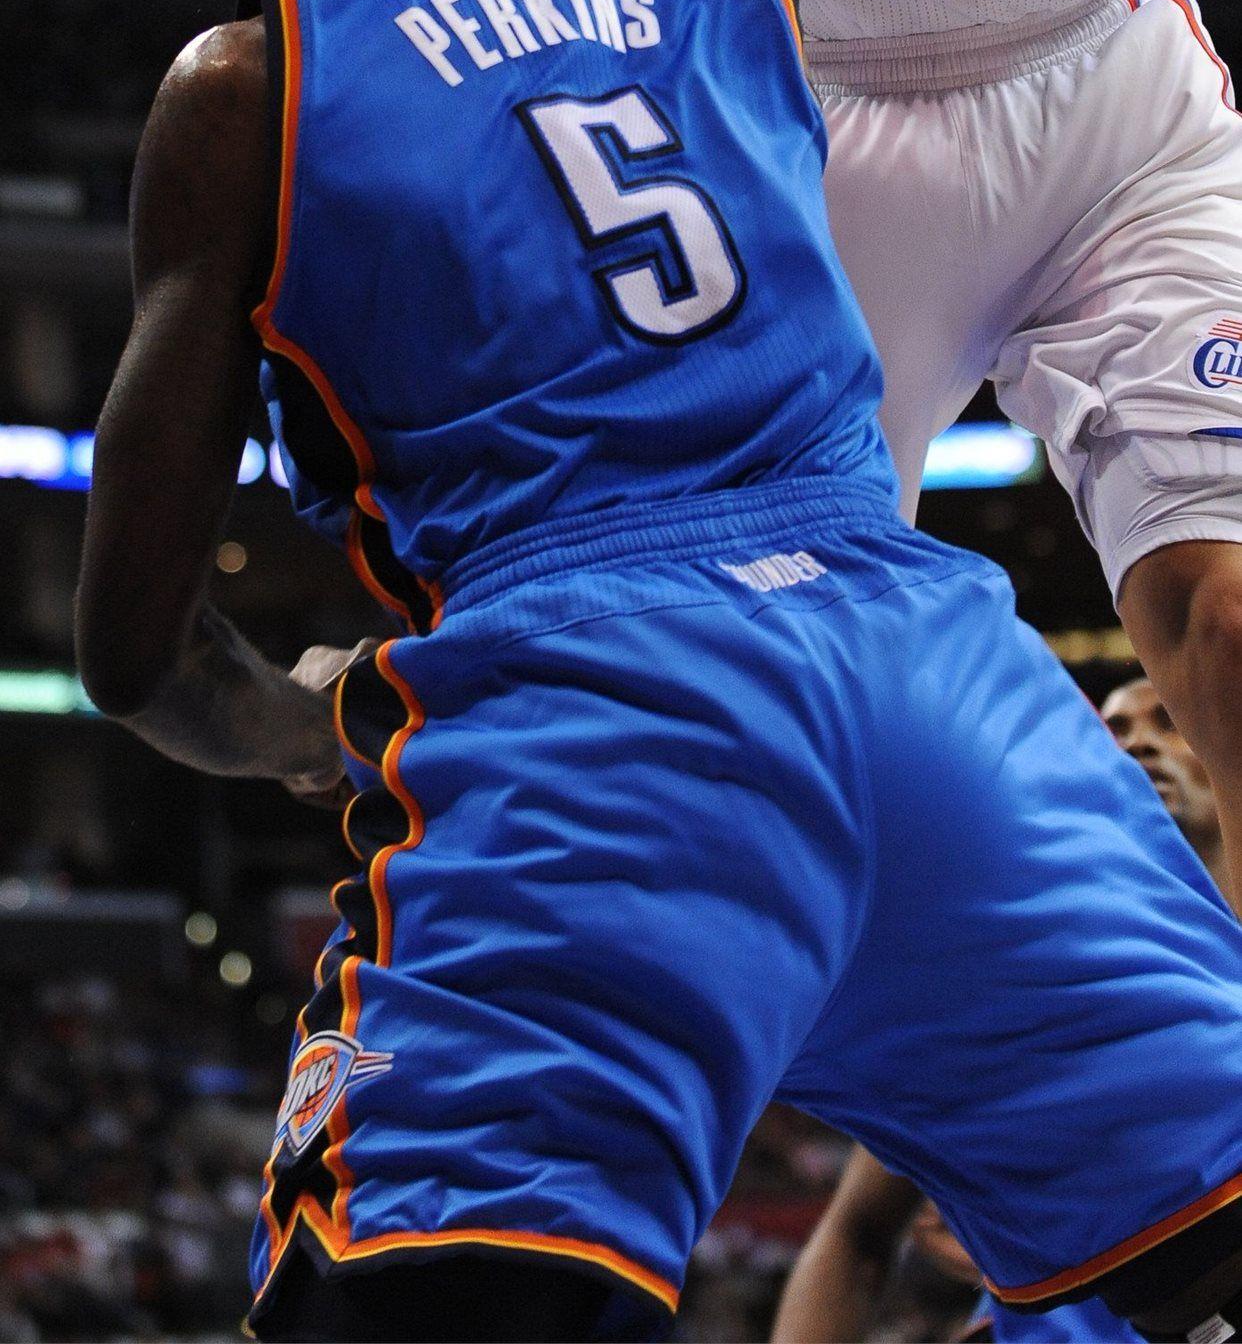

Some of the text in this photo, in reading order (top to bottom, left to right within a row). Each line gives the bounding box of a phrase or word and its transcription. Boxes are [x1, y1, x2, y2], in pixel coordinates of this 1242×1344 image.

[513, 83, 749, 347] 5
[1193, 337, 1242, 389] CLI
[277, 1054, 336, 1126] OKC
